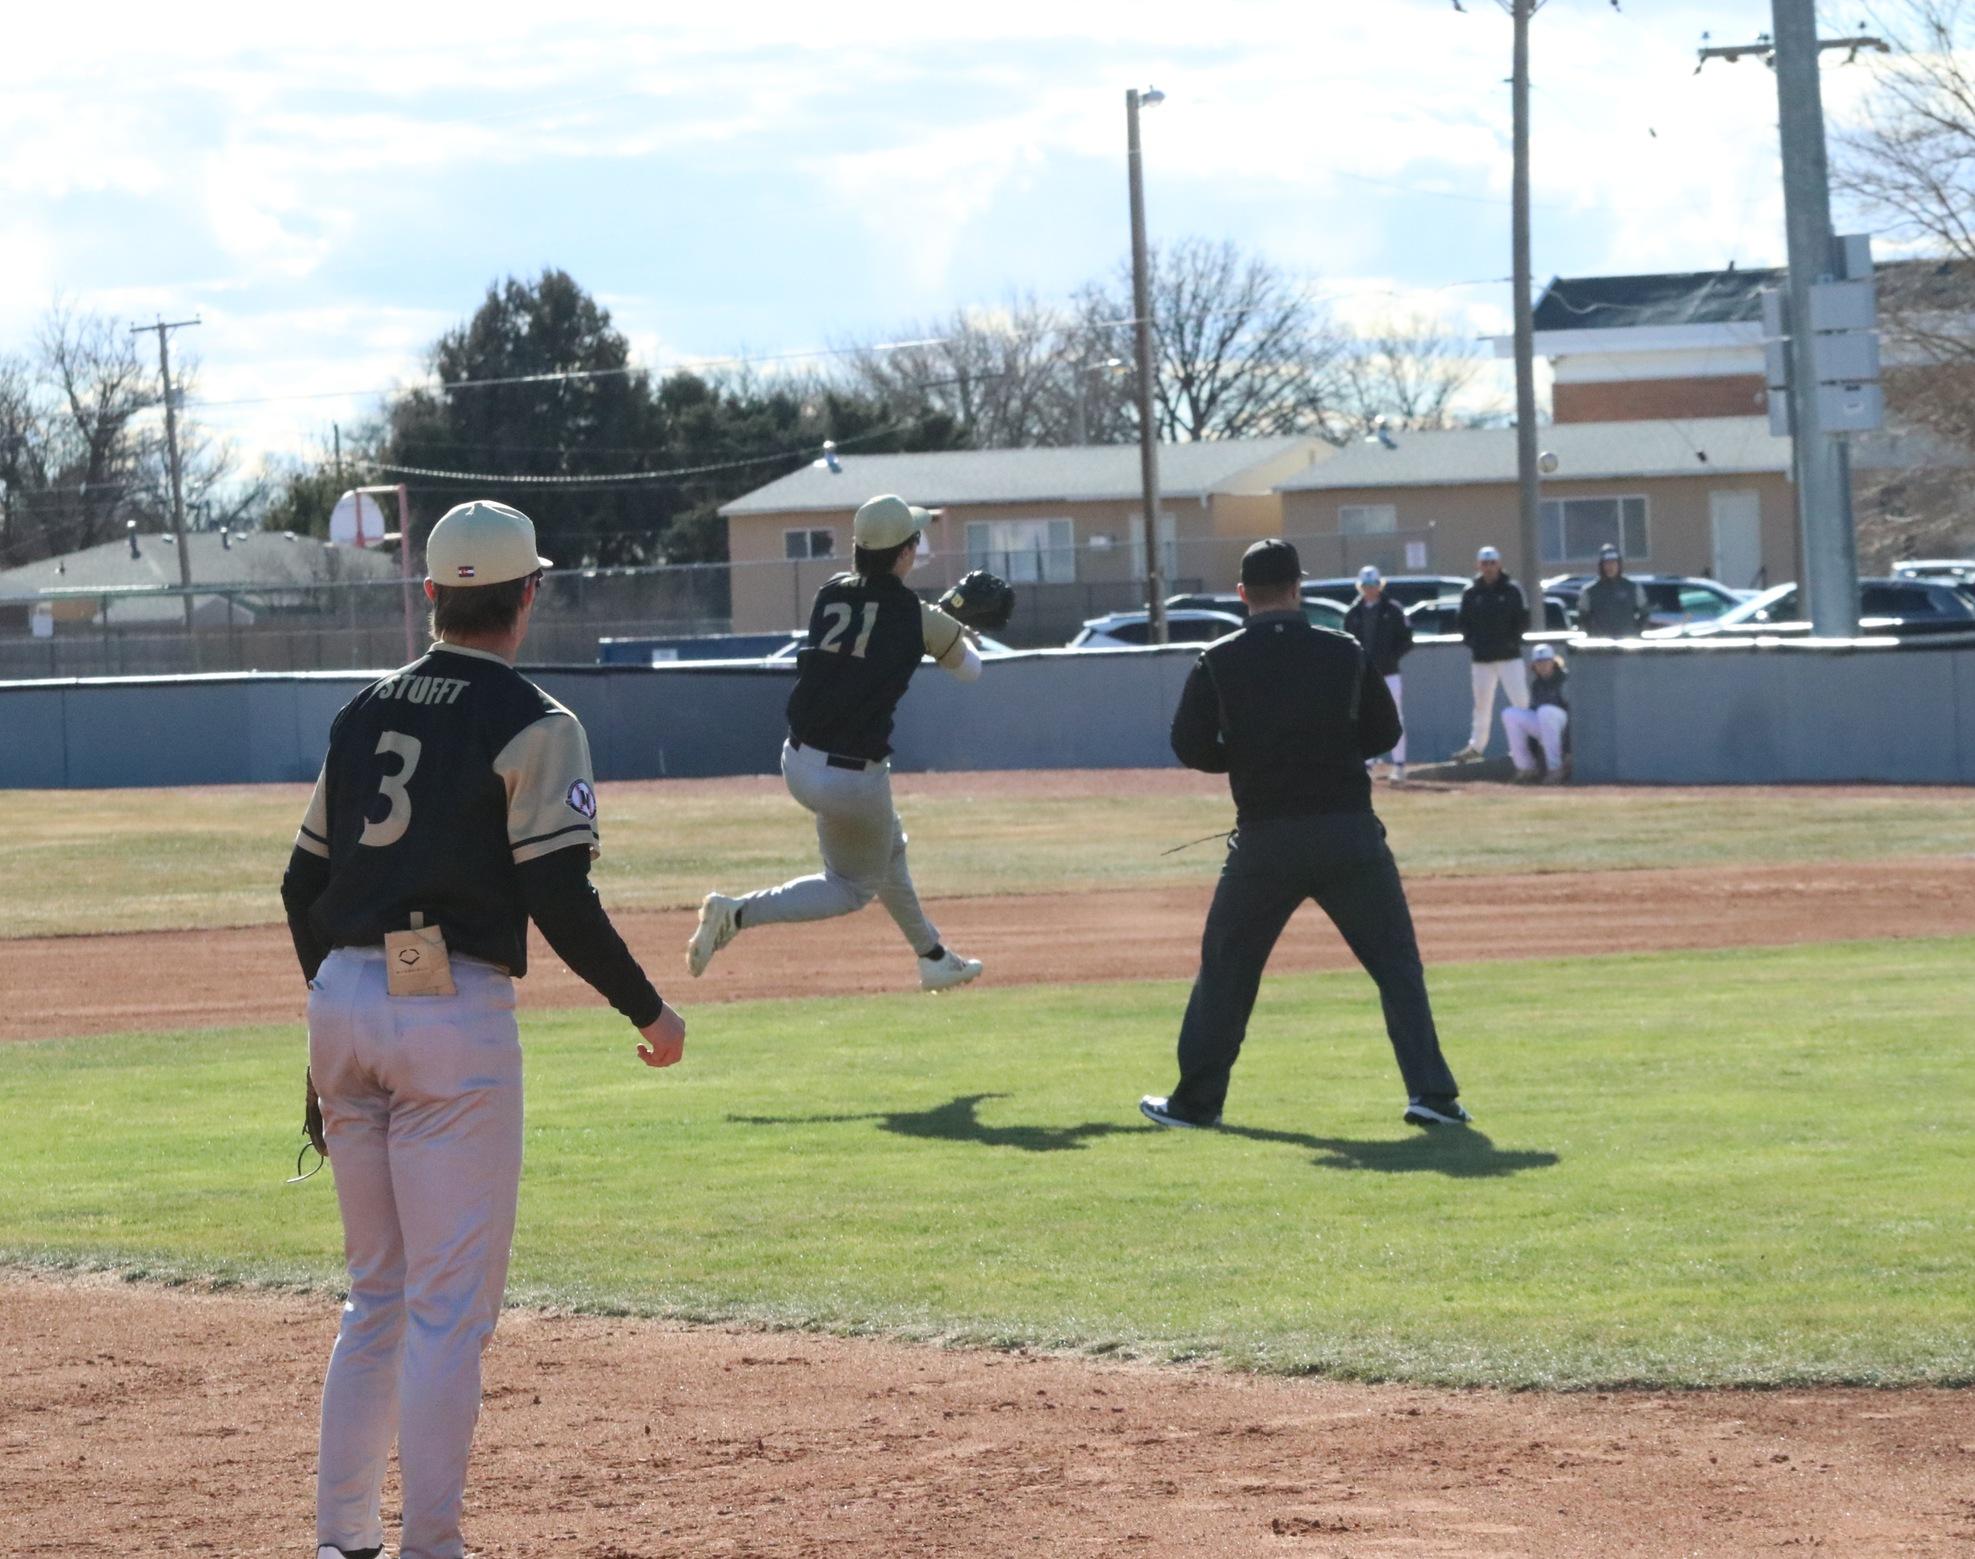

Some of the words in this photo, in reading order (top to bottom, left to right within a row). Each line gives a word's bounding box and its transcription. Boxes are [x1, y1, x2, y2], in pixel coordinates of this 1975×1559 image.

[819, 602, 879, 658] 21
[379, 674, 471, 704] STUFFT
[358, 730, 422, 847] 3
